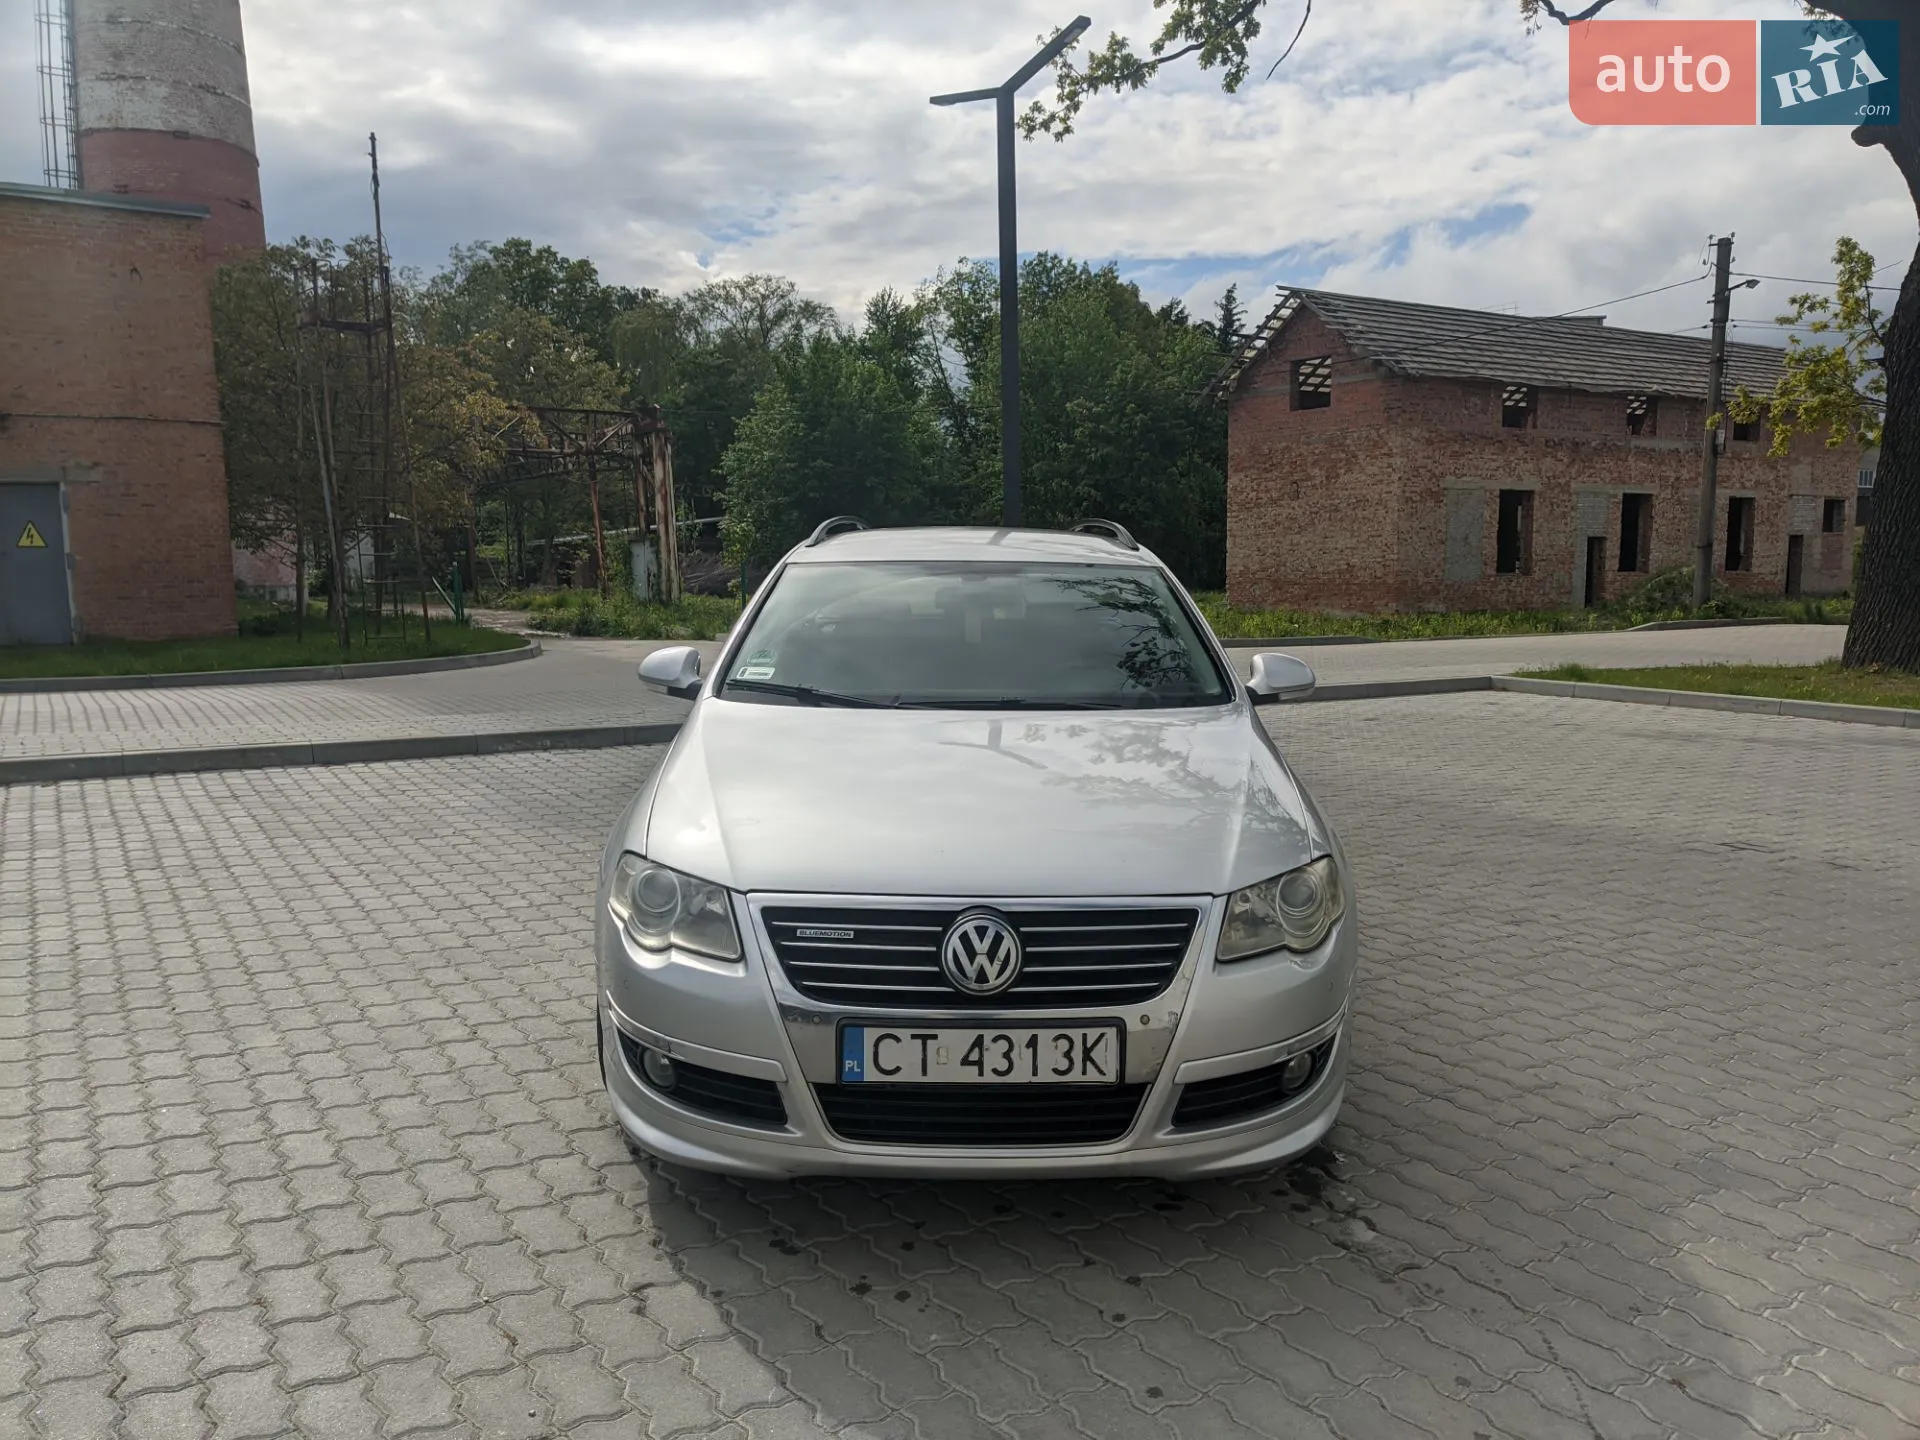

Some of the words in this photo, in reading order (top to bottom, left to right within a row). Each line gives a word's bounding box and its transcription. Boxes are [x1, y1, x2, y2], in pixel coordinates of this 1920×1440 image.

[799, 930, 852, 938] BLUEMOTION
[951, 924, 1014, 985] VW
[845, 1060, 861, 1072] PL
[872, 1032, 938, 1077] CT
[960, 1032, 1107, 1077] 4313K
